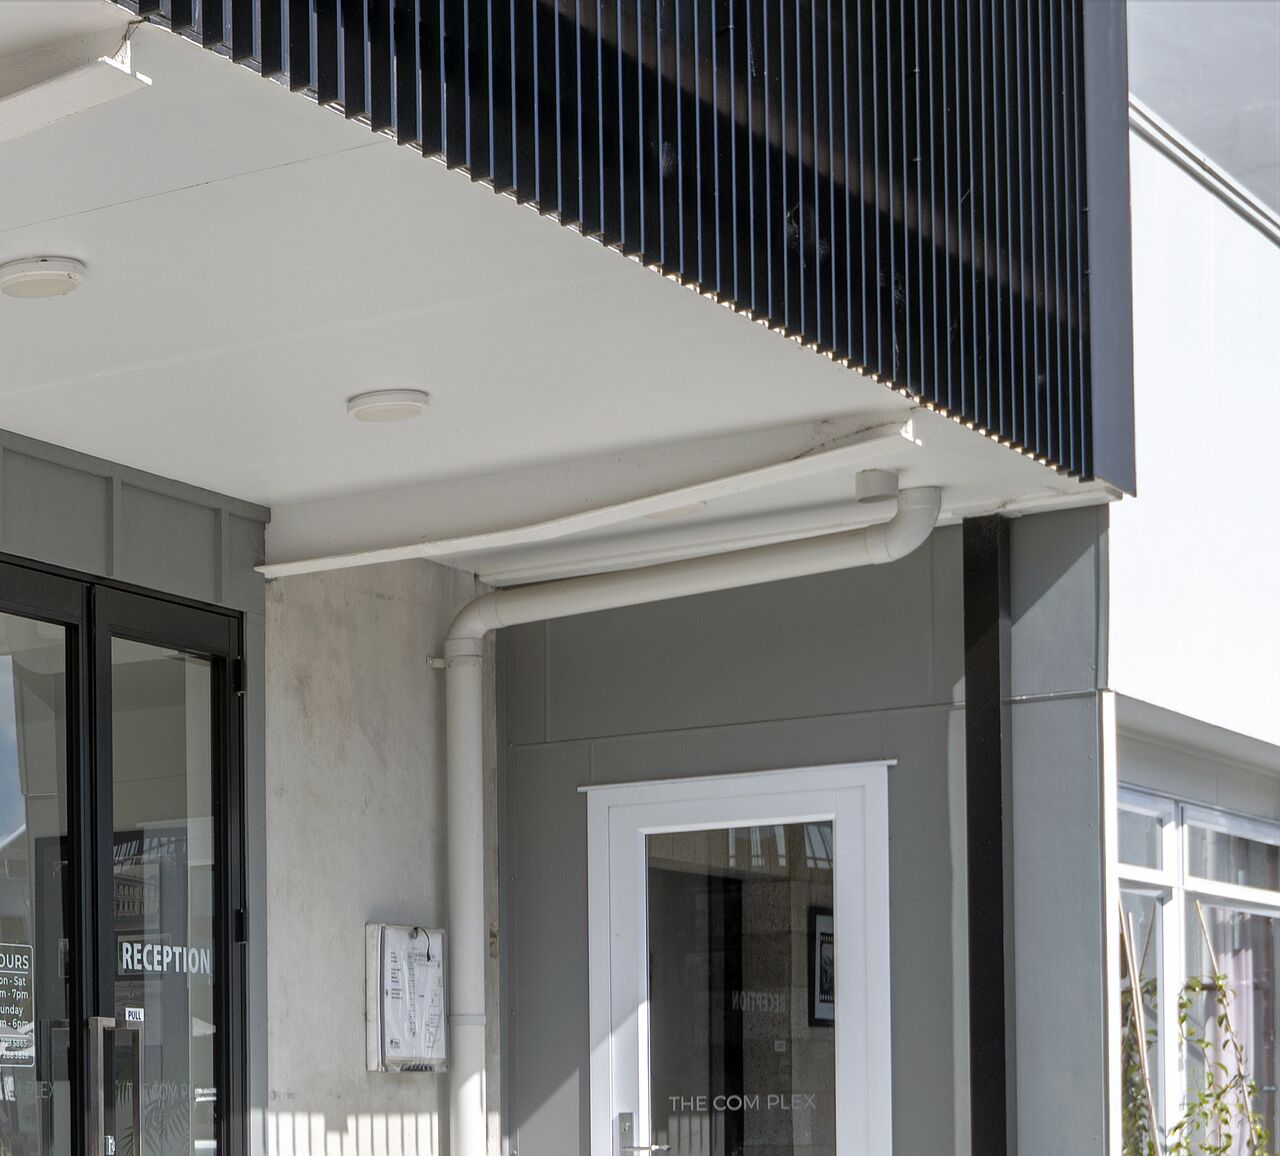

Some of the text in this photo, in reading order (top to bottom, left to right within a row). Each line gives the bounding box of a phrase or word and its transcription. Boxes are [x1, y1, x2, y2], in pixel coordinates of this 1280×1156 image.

[122, 942, 210, 974] RECEPTION
[13, 976, 26, 986] Sat
[12, 989, 28, 1000] 7pm
[127, 1010, 142, 1020] PULL
[12, 1019, 28, 1030] 6pm
[669, 1093, 817, 1112] THE COM PLEX
